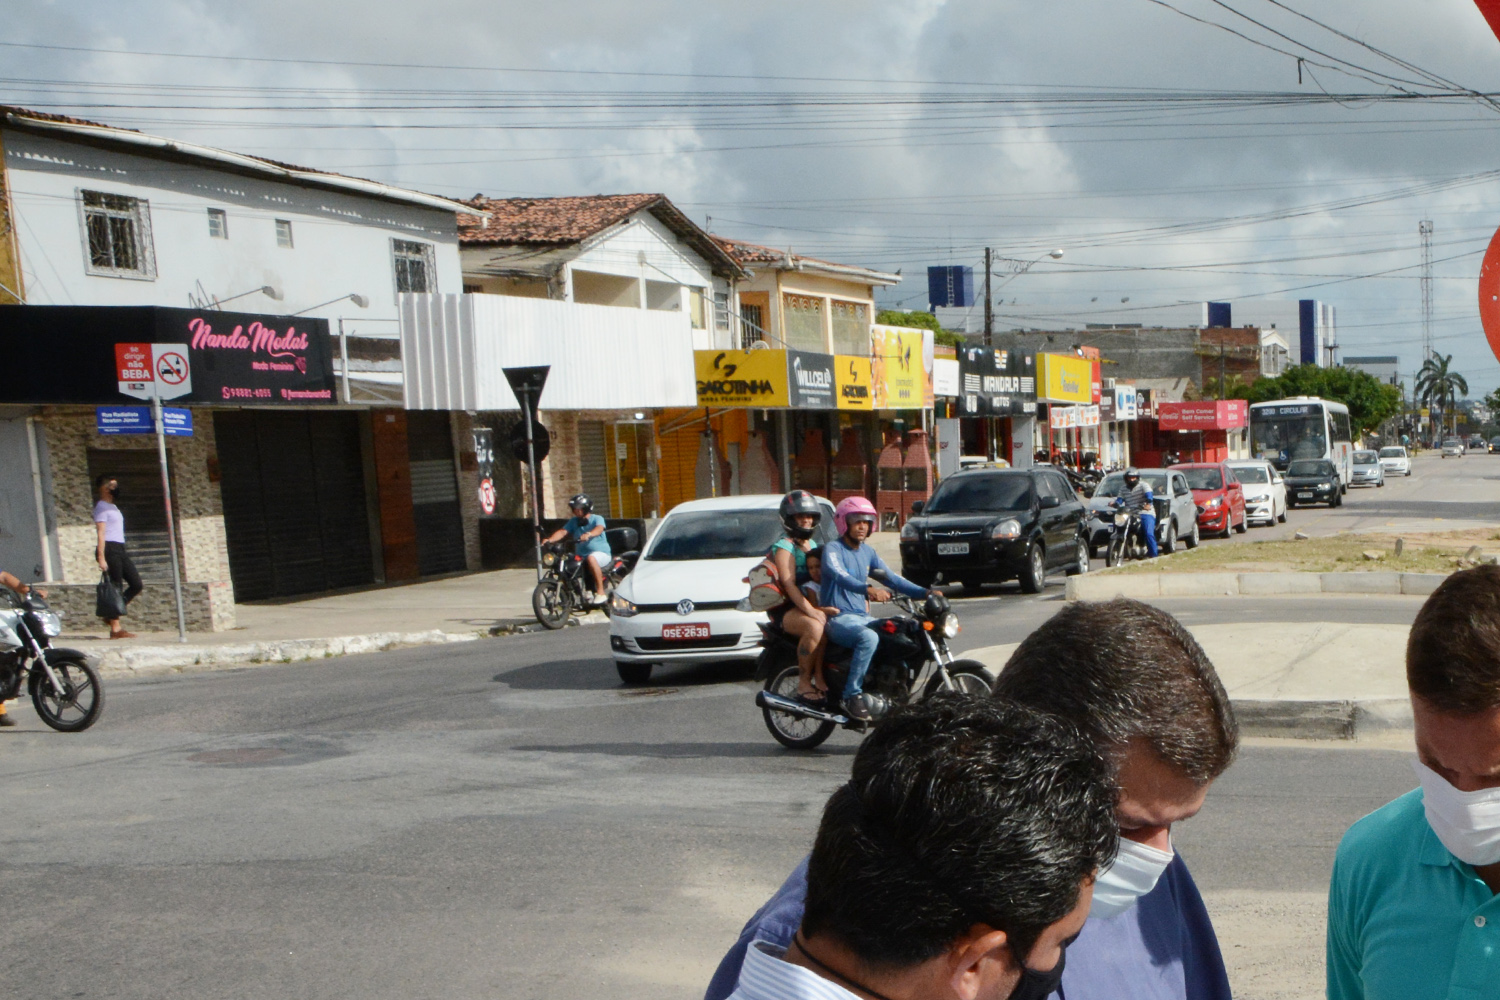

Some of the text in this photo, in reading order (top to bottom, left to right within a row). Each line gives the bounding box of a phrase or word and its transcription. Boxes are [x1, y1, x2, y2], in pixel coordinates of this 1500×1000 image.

[188, 318, 309, 357] Nanda Modas
[128, 360, 144, 368] não
[122, 369, 150, 379] BEBA
[983, 375, 1019, 393] MANDALA
[1279, 406, 1308, 415] CIRCULAR
